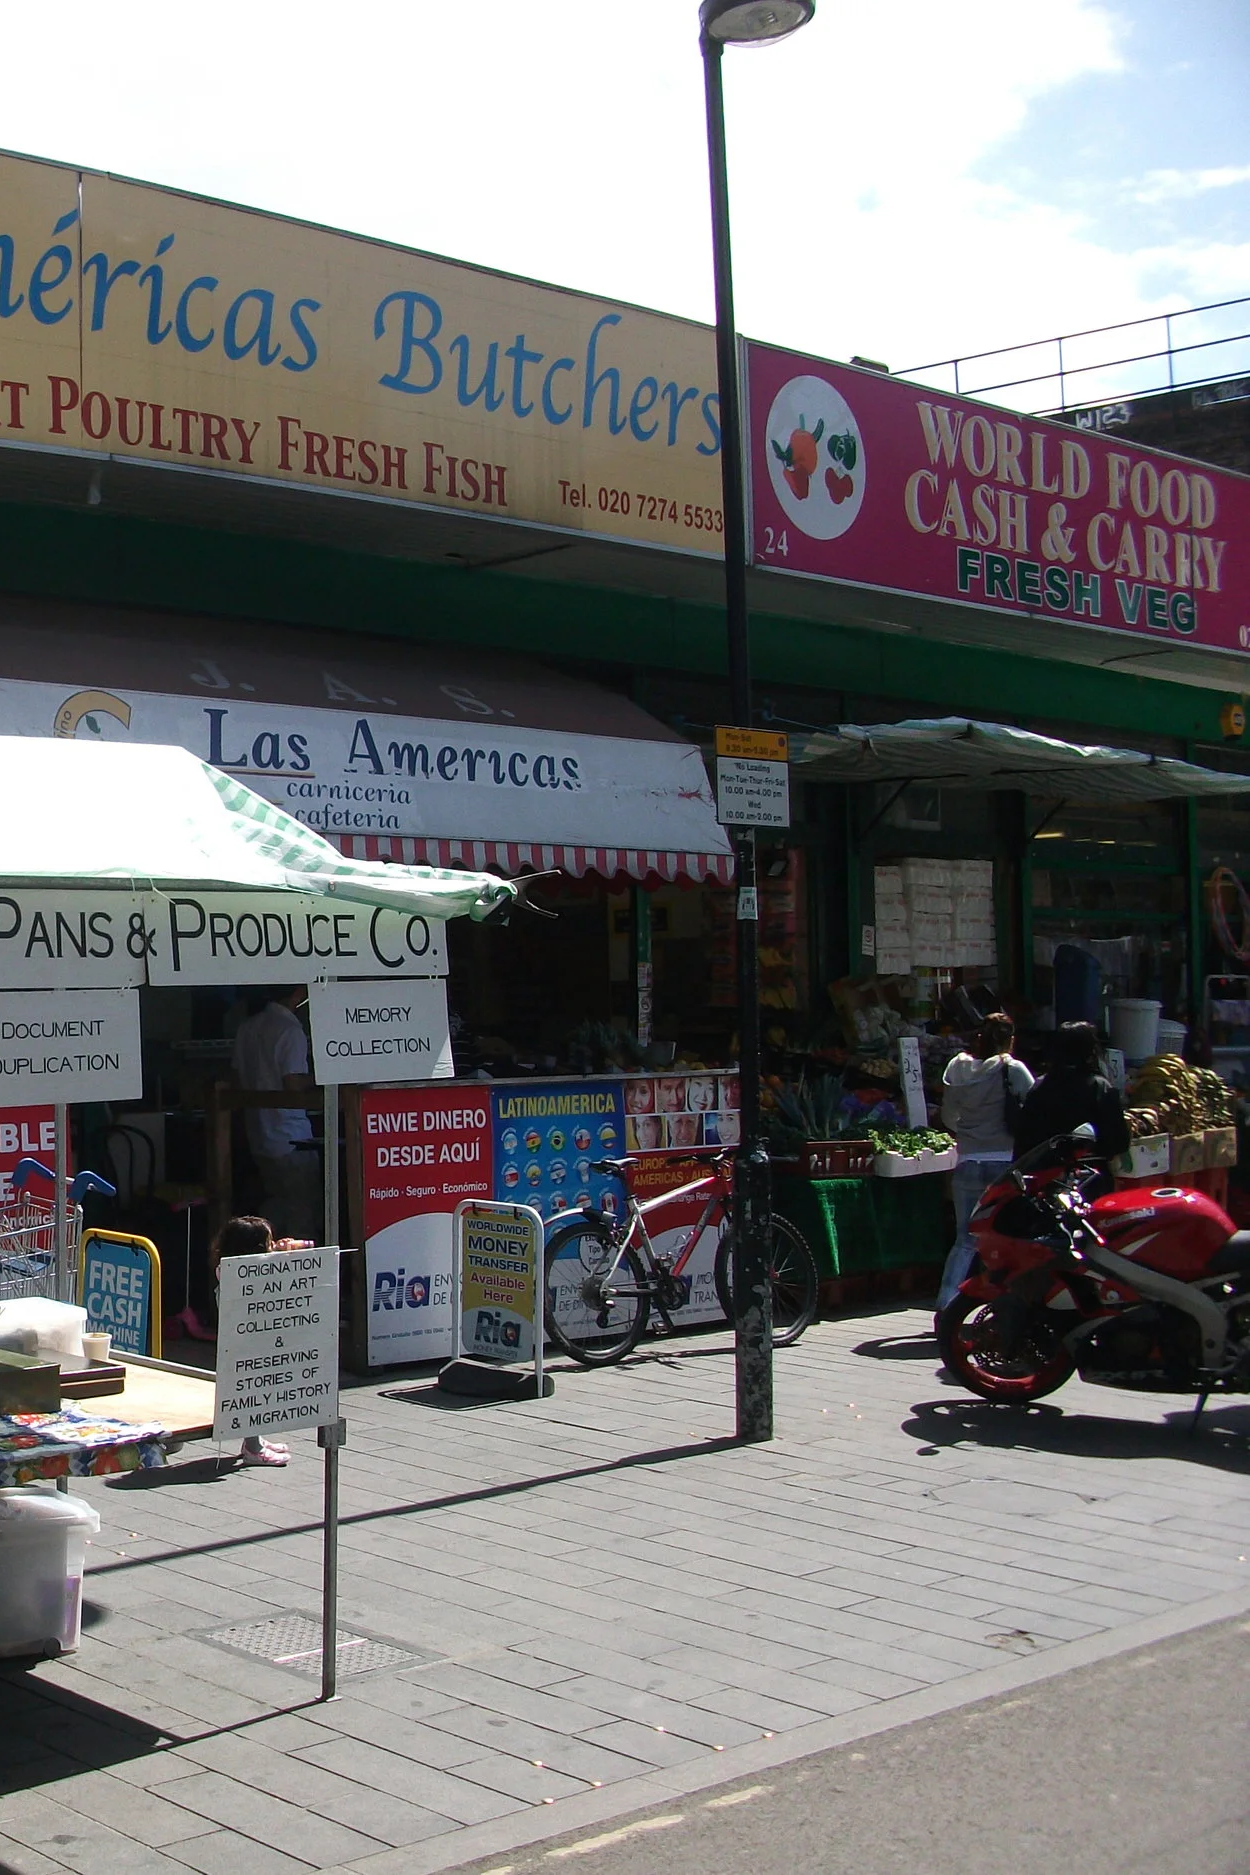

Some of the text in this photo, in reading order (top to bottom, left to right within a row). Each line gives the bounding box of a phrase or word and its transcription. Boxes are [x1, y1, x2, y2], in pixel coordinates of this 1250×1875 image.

[374, 290, 722, 457] Butchers
[47, 375, 261, 464] POULTRY
[277, 415, 408, 490] FRESH
[423, 441, 507, 507] FISH
[917, 401, 1216, 530] WORLD FOOD
[558, 480, 724, 534] Tel. 020 7274 5533
[765, 526, 789, 557] 24
[904, 469, 1227, 593] CASH & CARRY
[956, 546, 1198, 634] FRESH VEG
[204, 708, 582, 791] Las Americas
[287, 780, 412, 804] carniceria
[725, 786, 744, 795] 10.00
[294, 803, 401, 830] cafeteria
[726, 811, 745, 819] 10.00
[748, 801, 761, 809] Wed
[126, 912, 158, 959] &
[169, 898, 358, 972] PRODUCE
[345, 1006, 411, 1024] MEMORY
[1, 1019, 105, 1040] DOCUMENT
[326, 1037, 431, 1058] COLLECTION
[498, 1093, 616, 1119] LATINOAMERICA
[367, 1108, 486, 1134] ENVIE DINERO
[377, 1144, 435, 1168] DESDE
[439, 1137, 480, 1164] AQUÍ
[369, 1181, 488, 1200] Rápido Seguro Económico
[633, 1171, 684, 1187] AMERICAS
[467, 1220, 529, 1236] WORLDWIDE
[468, 1235, 529, 1256] MONEY
[237, 1257, 322, 1279] ORIGINATION
[468, 1255, 529, 1274] TRANSFER
[89, 1259, 144, 1299] FREE
[242, 1276, 317, 1296] IS AN ART
[372, 1268, 431, 1312] Ria
[470, 1272, 526, 1290] Available
[247, 1295, 313, 1315] PROJECT
[433, 1292, 447, 1305] DE
[484, 1290, 513, 1303] Here
[87, 1292, 141, 1328] CASH
[87, 1320, 140, 1346] MACHINE
[236, 1313, 320, 1334] COLLECTING
[474, 1310, 522, 1348] Ria
[275, 1336, 284, 1348] &
[236, 1349, 319, 1373] PRESERVING
[236, 1367, 320, 1392] STORIES OF
[221, 1382, 331, 1412] FAMILY HISTORY
[231, 1404, 319, 1430] & MIGRATION
